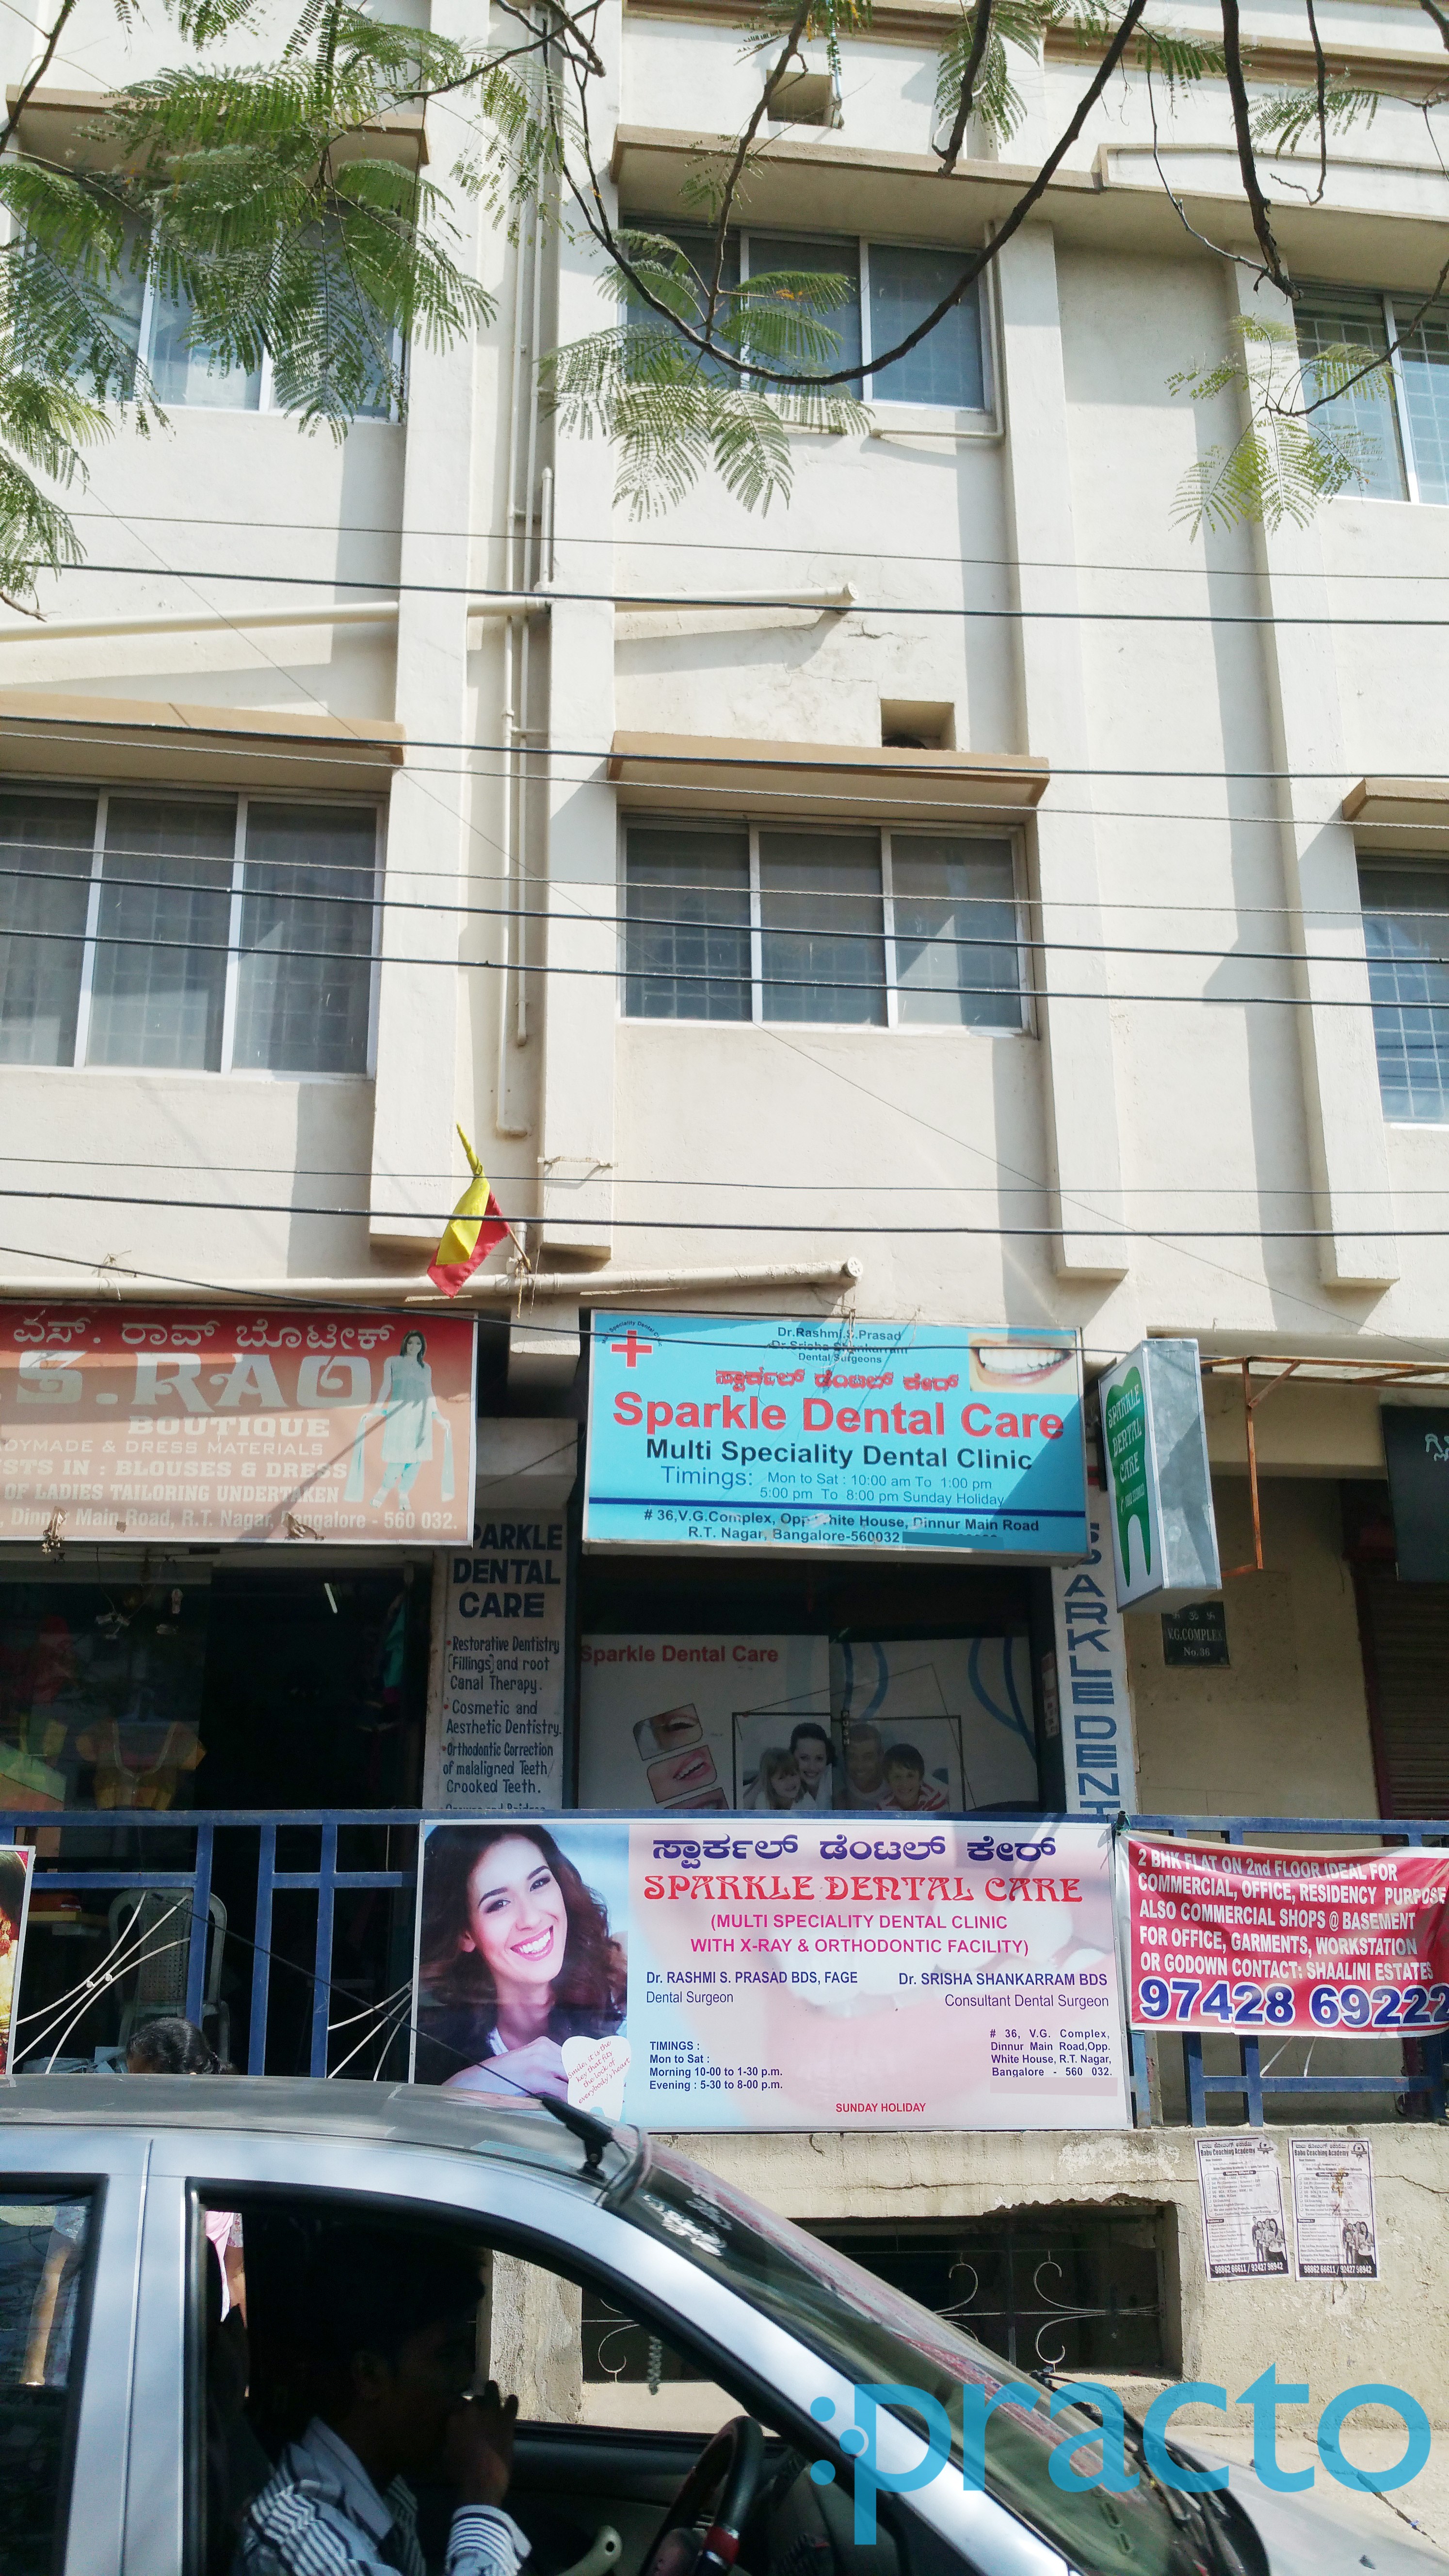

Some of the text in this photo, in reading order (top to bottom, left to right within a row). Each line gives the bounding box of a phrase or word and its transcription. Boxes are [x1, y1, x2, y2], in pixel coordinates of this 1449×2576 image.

[799, 1352, 882, 1364] Dental Surgeons
[613, 1391, 1064, 1440] Sparkle Dental Care
[1108, 1384, 1140, 1429] SPARKLE
[129, 1415, 330, 1438] BOUTIQUE
[1112, 1417, 1142, 1457] DENTAL
[102, 1440, 115, 1453] &
[126, 1440, 197, 1454] DRESS
[208, 1441, 323, 1455] MATERIALS
[647, 1439, 1032, 1470] Multi Speciality Dental Clinic
[1119, 1451, 1140, 1483] CARE
[660, 1465, 753, 1489] Timings:
[768, 1472, 796, 1484] Mon
[800, 1473, 812, 1484] to
[817, 1473, 838, 1485] Sat
[852, 1475, 886, 1486] 10:00
[891, 1478, 911, 1487] am
[915, 1476, 932, 1487] To
[941, 1477, 967, 1489] 1:00
[972, 1480, 992, 1491] pm
[4, 1484, 339, 1503] OF LADIES TAILORING UNDERTAKEN
[473, 1524, 563, 1550] ARKLE
[689, 1526, 715, 1538] R.T.
[773, 1529, 900, 1543] Bangalore-560032
[453, 1558, 561, 1584] DENTAL
[459, 1592, 545, 1618] CARE
[452, 1636, 560, 1655] Restorative Dentistry
[497, 1657, 518, 1671] and
[523, 1657, 549, 1671] root
[581, 1644, 779, 1667] Sparkle Dental Care
[450, 1675, 483, 1690] Canal
[452, 1699, 538, 1715] Cosmetic and
[505, 1719, 562, 1737] Dentistry.
[447, 1742, 554, 1756] Orthodontic Correction
[443, 1760, 454, 1775] of
[456, 1760, 515, 1777] malaligned
[446, 1779, 498, 1793] Crooked
[1138, 1849, 1398, 1882] 2 BHK FLAT ON 2nd FLOOR IDEAL FOR
[644, 1875, 1083, 1902] SPARKLE DENTAL CARE
[1138, 1872, 1238, 1901] COMMERCIAL,
[1241, 1880, 1295, 1905] OFFICE,
[1299, 1883, 1377, 1905] RESIDENCY
[711, 1914, 1008, 1931] (MULTI SPECIALITY DENTAL CLINIC
[691, 1938, 1029, 1956] WITH X-RAY & ORTHODONTIC FACILITY)
[1141, 1952, 1433, 1981] OR GODOWN CONTACT: SHAALINI ESTATES
[647, 1971, 858, 1985] Dr. RASHMI S. PRASAD BDS, FAGE
[899, 1972, 1108, 1986] Dr. SRISHA SHANKARRAM BDS
[646, 1991, 734, 2006] Dental Surgeon
[945, 1994, 1109, 2010] Consultant Dental Surgeon
[1139, 1976, 1449, 2028] 97428 69222
[588, 2054, 594, 2062] it
[600, 2041, 612, 2052] the
[650, 2067, 783, 2078] Morning 10-00 to 1-30 p.m.
[650, 2080, 691, 2091] Evening
[700, 2080, 722, 2089] 5-30
[724, 2080, 734, 2089] to
[737, 2080, 758, 2089] 8-00
[761, 2082, 783, 2091] p.m.
[836, 2103, 926, 2112] SUNDAY HOLIDAY
